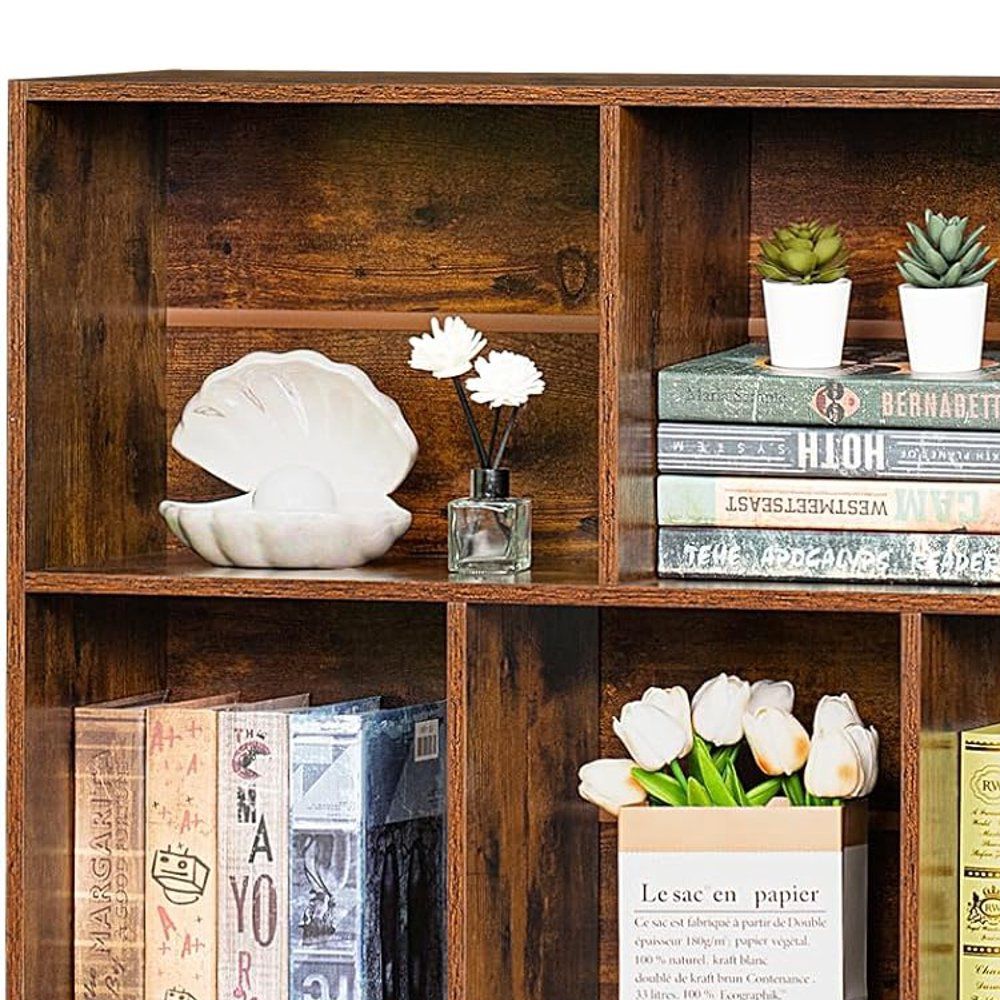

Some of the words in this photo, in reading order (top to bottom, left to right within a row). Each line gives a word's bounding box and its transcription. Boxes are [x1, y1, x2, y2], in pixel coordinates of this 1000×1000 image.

[798, 432, 886, 471] HOTH
[726, 495, 888, 516] WESTMEETSEAST
[643, 883, 667, 903] Le
[673, 890, 703, 903] sac
[713, 890, 737, 903] en
[755, 885, 820, 909] papier
[634, 917, 650, 929] Ce
[652, 919, 667, 929] sac
[669, 918, 685, 929] est
[773, 917, 787, 929] de
[788, 917, 827, 929] Double
[636, 955, 654, 965] 100
[713, 954, 737, 966] kraft
[739, 954, 768, 966] blanc
[690, 971, 715, 984] kraft
[717, 972, 744, 984] brun
[683, 989, 702, 1000] 100
